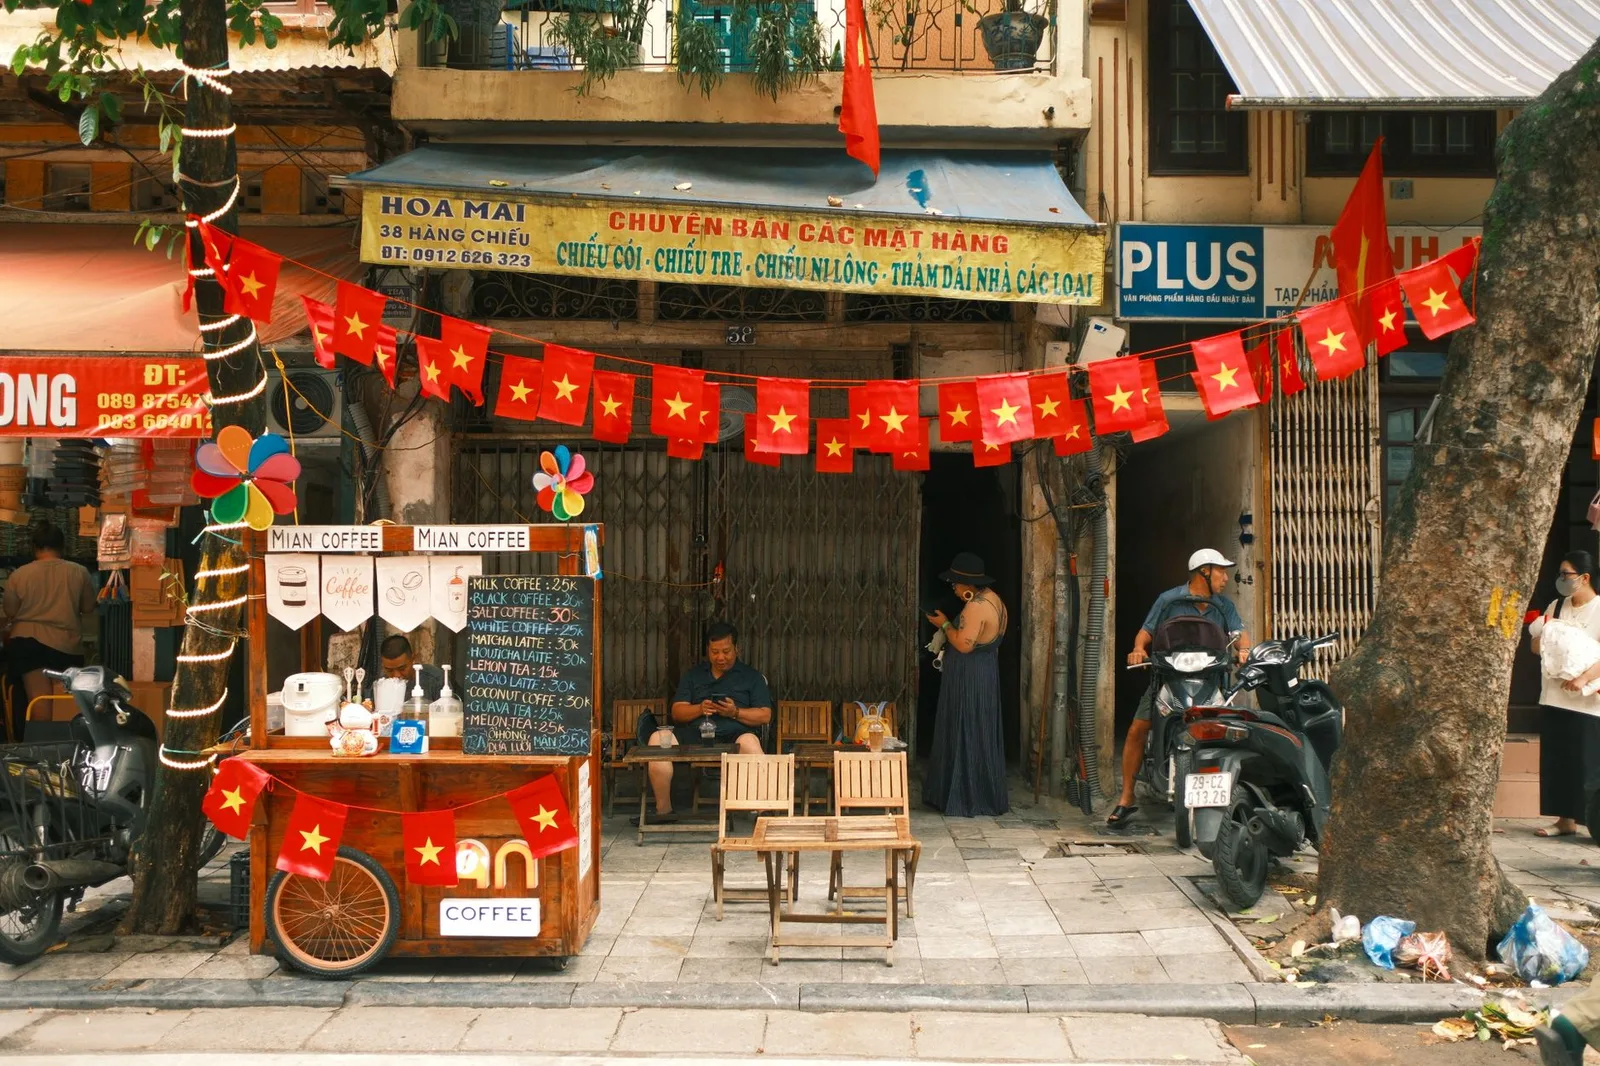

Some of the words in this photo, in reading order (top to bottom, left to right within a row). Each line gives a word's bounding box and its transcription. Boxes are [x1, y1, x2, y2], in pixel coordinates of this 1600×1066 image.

[381, 196, 454, 217] HOA
[463, 201, 525, 222] MAI
[380, 225, 403, 238] 38
[409, 224, 465, 242] HÀNG
[471, 227, 530, 246] CHIẾU
[609, 211, 722, 236] CHUYÊN
[731, 216, 789, 240] BÁN
[798, 220, 855, 244] CÁC
[863, 226, 923, 252] MẶT
[931, 229, 1009, 254] HÀNG
[381, 246, 407, 259] ĐT:
[412, 248, 457, 262] 0912
[461, 250, 493, 264] 626
[498, 253, 531, 267] 323
[556, 232, 610, 269] CHIẾU
[613, 238, 642, 271] CÓI
[654, 238, 707, 275] CHIẾU
[711, 250, 742, 276] TRE
[755, 244, 807, 280] CHIẾU
[891, 252, 939, 288] THẢM
[976, 261, 1012, 293] NHÀ
[1016, 263, 1049, 294] CÁC
[1053, 272, 1093, 303] LOẠI
[1122, 241, 1257, 291] PLUS
[1275, 287, 1299, 304] TẠP
[144, 364, 186, 386] ĐT:
[97, 393, 136, 409] 089
[98, 413, 136, 429] 083
[321, 531, 379, 549] COFFEE
[467, 530, 526, 548] COFFEE
[325, 576, 369, 600] Coffee
[473, 578, 499, 590] MILK
[472, 592, 508, 605] BLACK
[471, 605, 500, 619] SALT
[470, 620, 509, 633] WHITE
[470, 634, 513, 647] MATCHA
[470, 660, 507, 673] LEMON
[470, 673, 507, 685] CACAO
[469, 686, 522, 700] COCONUT
[470, 700, 510, 714] GUAVA
[470, 714, 508, 728] MELON
[445, 906, 532, 922] COFFEE
